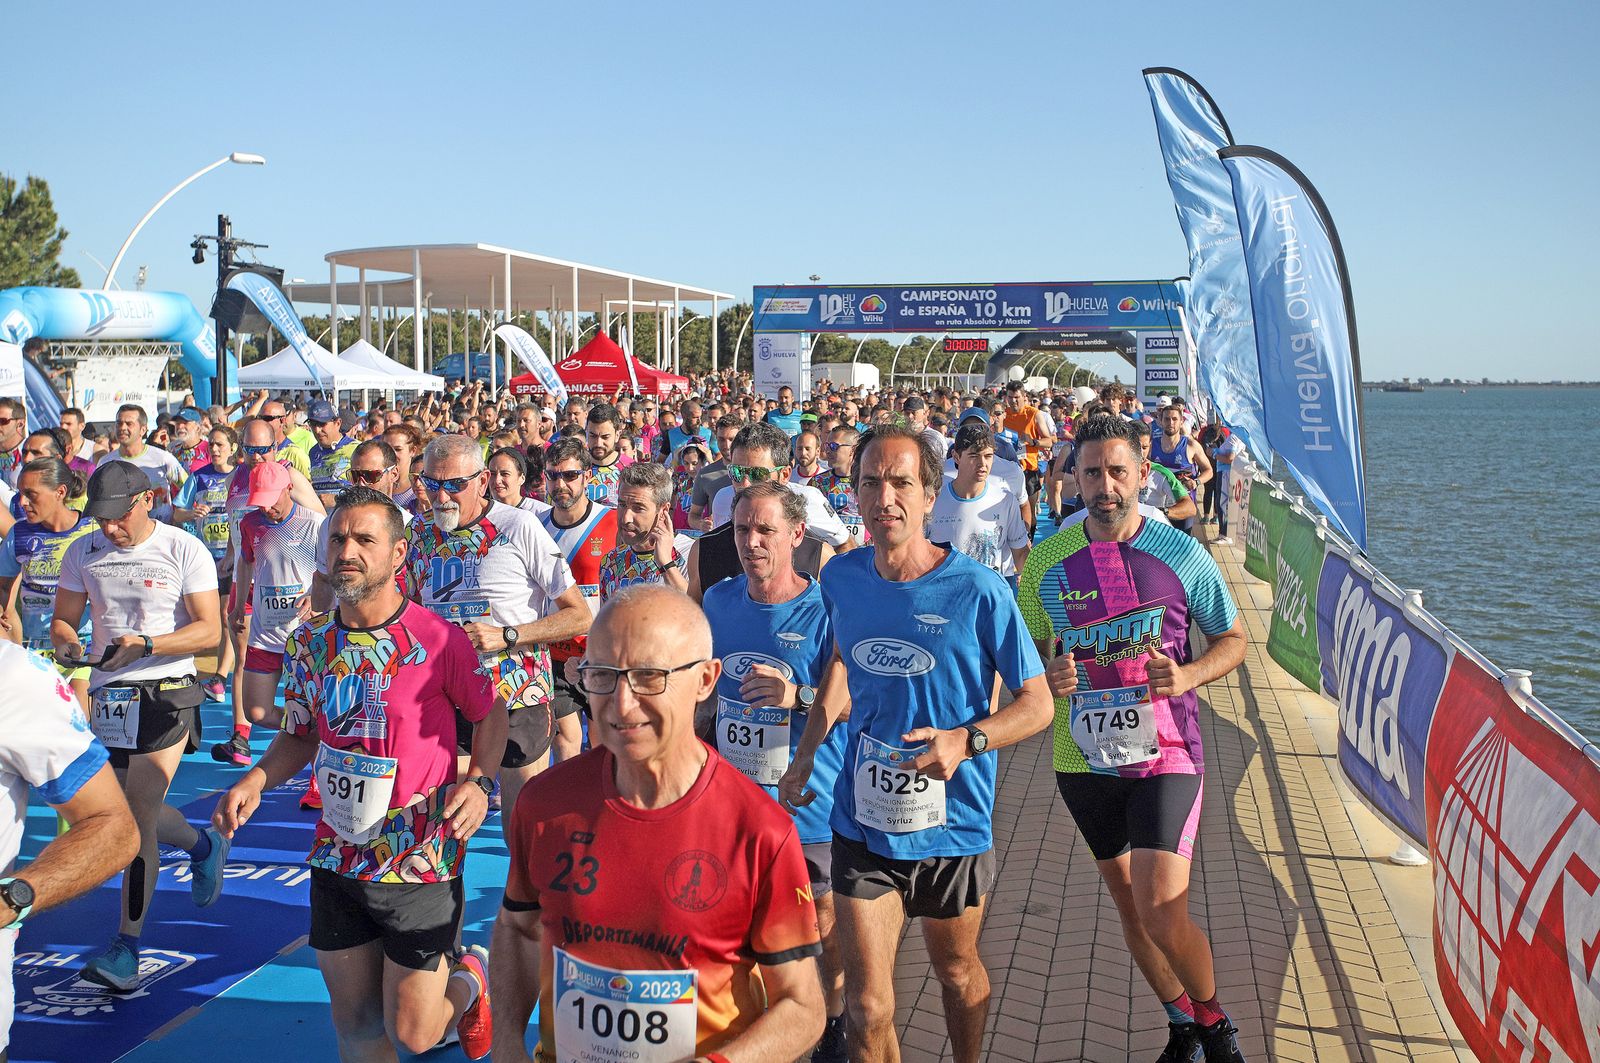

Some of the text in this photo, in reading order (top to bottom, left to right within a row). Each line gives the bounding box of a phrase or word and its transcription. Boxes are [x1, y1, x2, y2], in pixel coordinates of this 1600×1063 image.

[900, 289, 997, 302] CAMPEONATO
[114, 300, 154, 320] HUELVA
[900, 301, 1031, 318] de ESPAÑA 10 km
[1068, 297, 1109, 310] HUELVA
[1142, 299, 1180, 311] WiHu
[862, 314, 884, 322] WiHu
[997, 319, 1003, 327] y
[516, 383, 604, 394] SPORANIACS
[91, 571, 119, 579] CIUDAD
[131, 571, 168, 580] GRANADA
[1058, 590, 1098, 601] KIA
[264, 596, 297, 610] 1087
[464, 604, 485, 615] 2023
[1065, 603, 1088, 611] VEYSER
[917, 624, 944, 636] TYSA
[778, 641, 801, 650] TYSA
[866, 643, 916, 672] Ford
[95, 702, 125, 720] 614
[758, 711, 782, 722] 2023
[1081, 708, 1141, 734] 1749
[727, 722, 765, 749] 631
[742, 750, 766, 759] ALONSO
[360, 761, 387, 775] 2023
[867, 764, 929, 795] 1525
[327, 772, 365, 804] 591
[336, 803, 351, 812] JESUS
[889, 797, 918, 805] IGNACIO
[895, 802, 935, 813] FERNANDEZ
[886, 816, 913, 826] Syrluz
[549, 852, 600, 896] 23
[561, 916, 689, 960] DEPORTEMANIA
[576, 969, 606, 989] HUELVA
[639, 980, 682, 999] 2023
[572, 996, 669, 1045] 1008
[590, 1043, 640, 1060] VENANCIO
